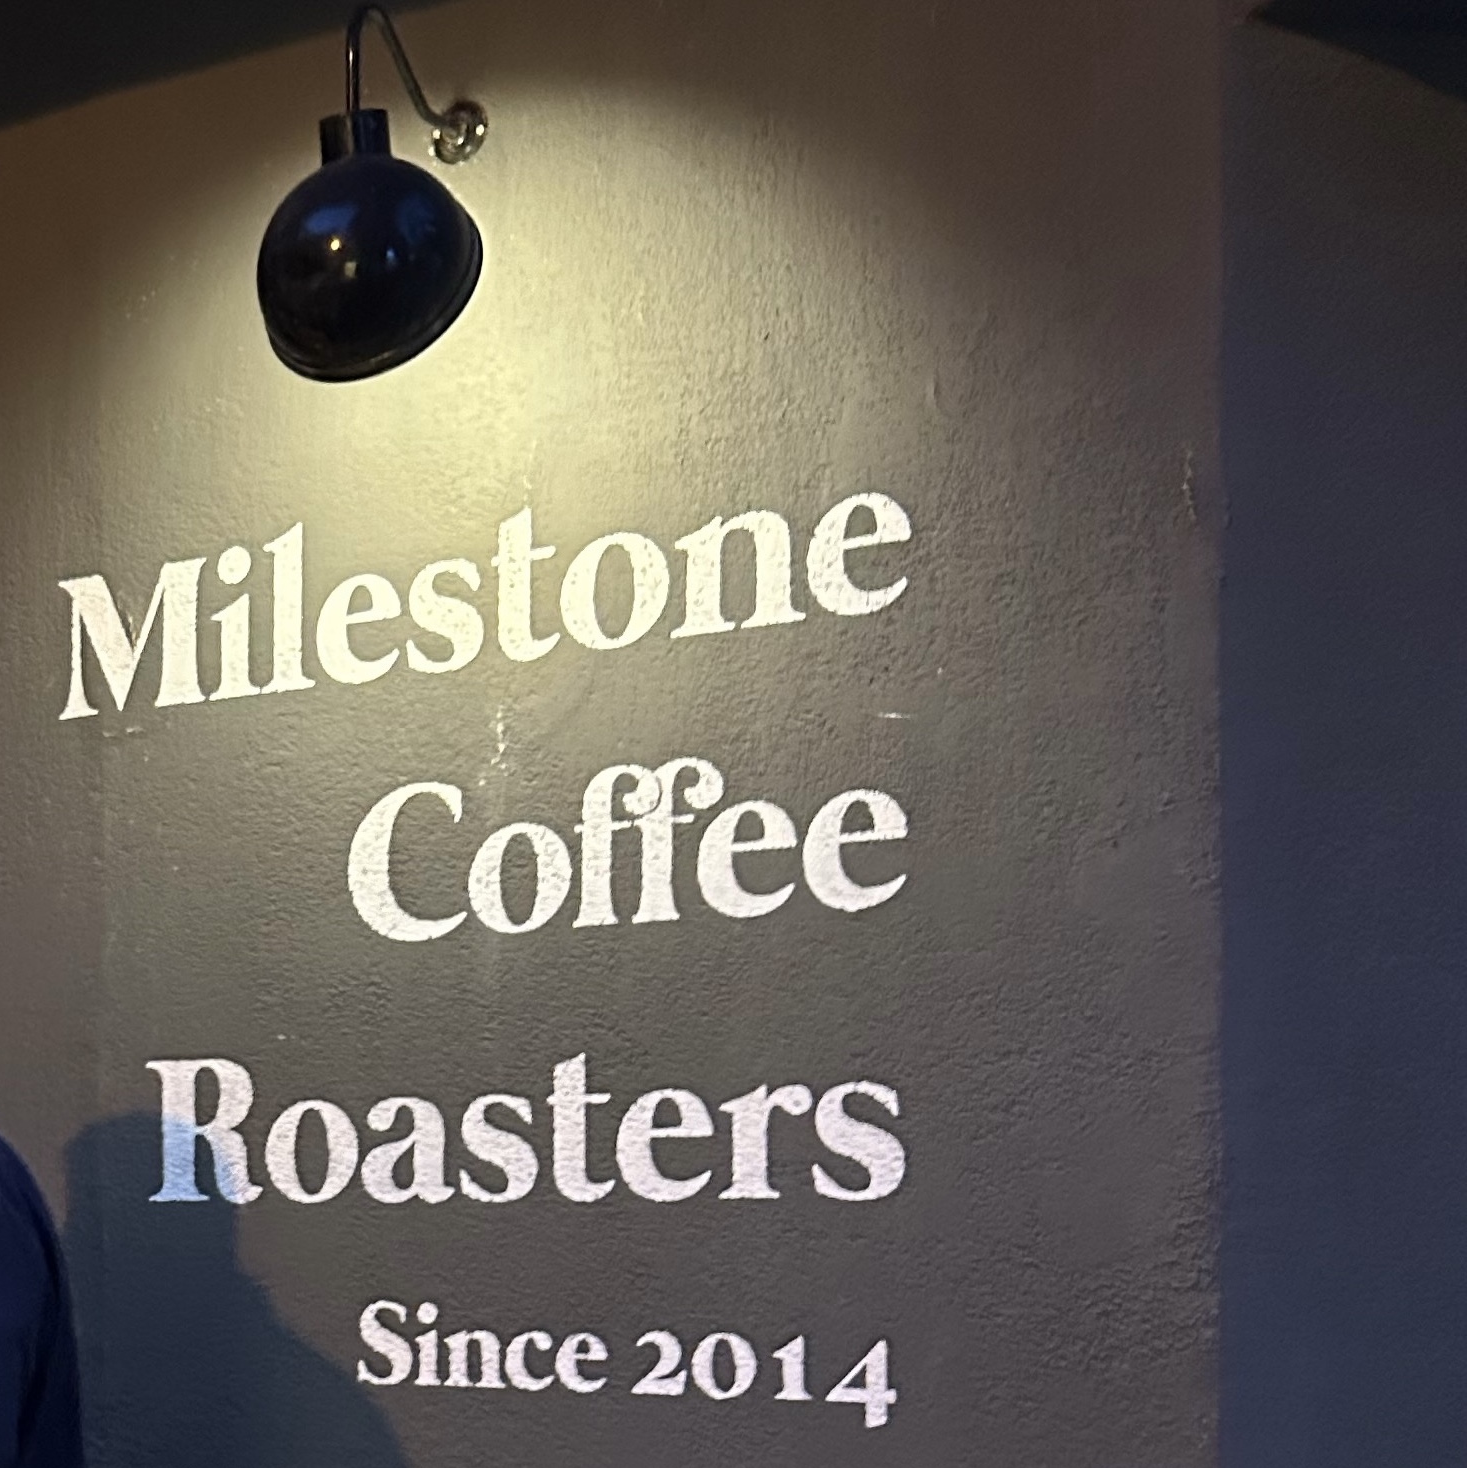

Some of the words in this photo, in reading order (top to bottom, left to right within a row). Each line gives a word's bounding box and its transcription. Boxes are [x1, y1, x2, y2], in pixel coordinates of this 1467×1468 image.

[57, 491, 912, 721] Milestone
[347, 756, 909, 942] Coffee
[145, 1052, 906, 1205] Roasters
[357, 1299, 609, 1394] Since
[631, 1330, 897, 1429] 2014
